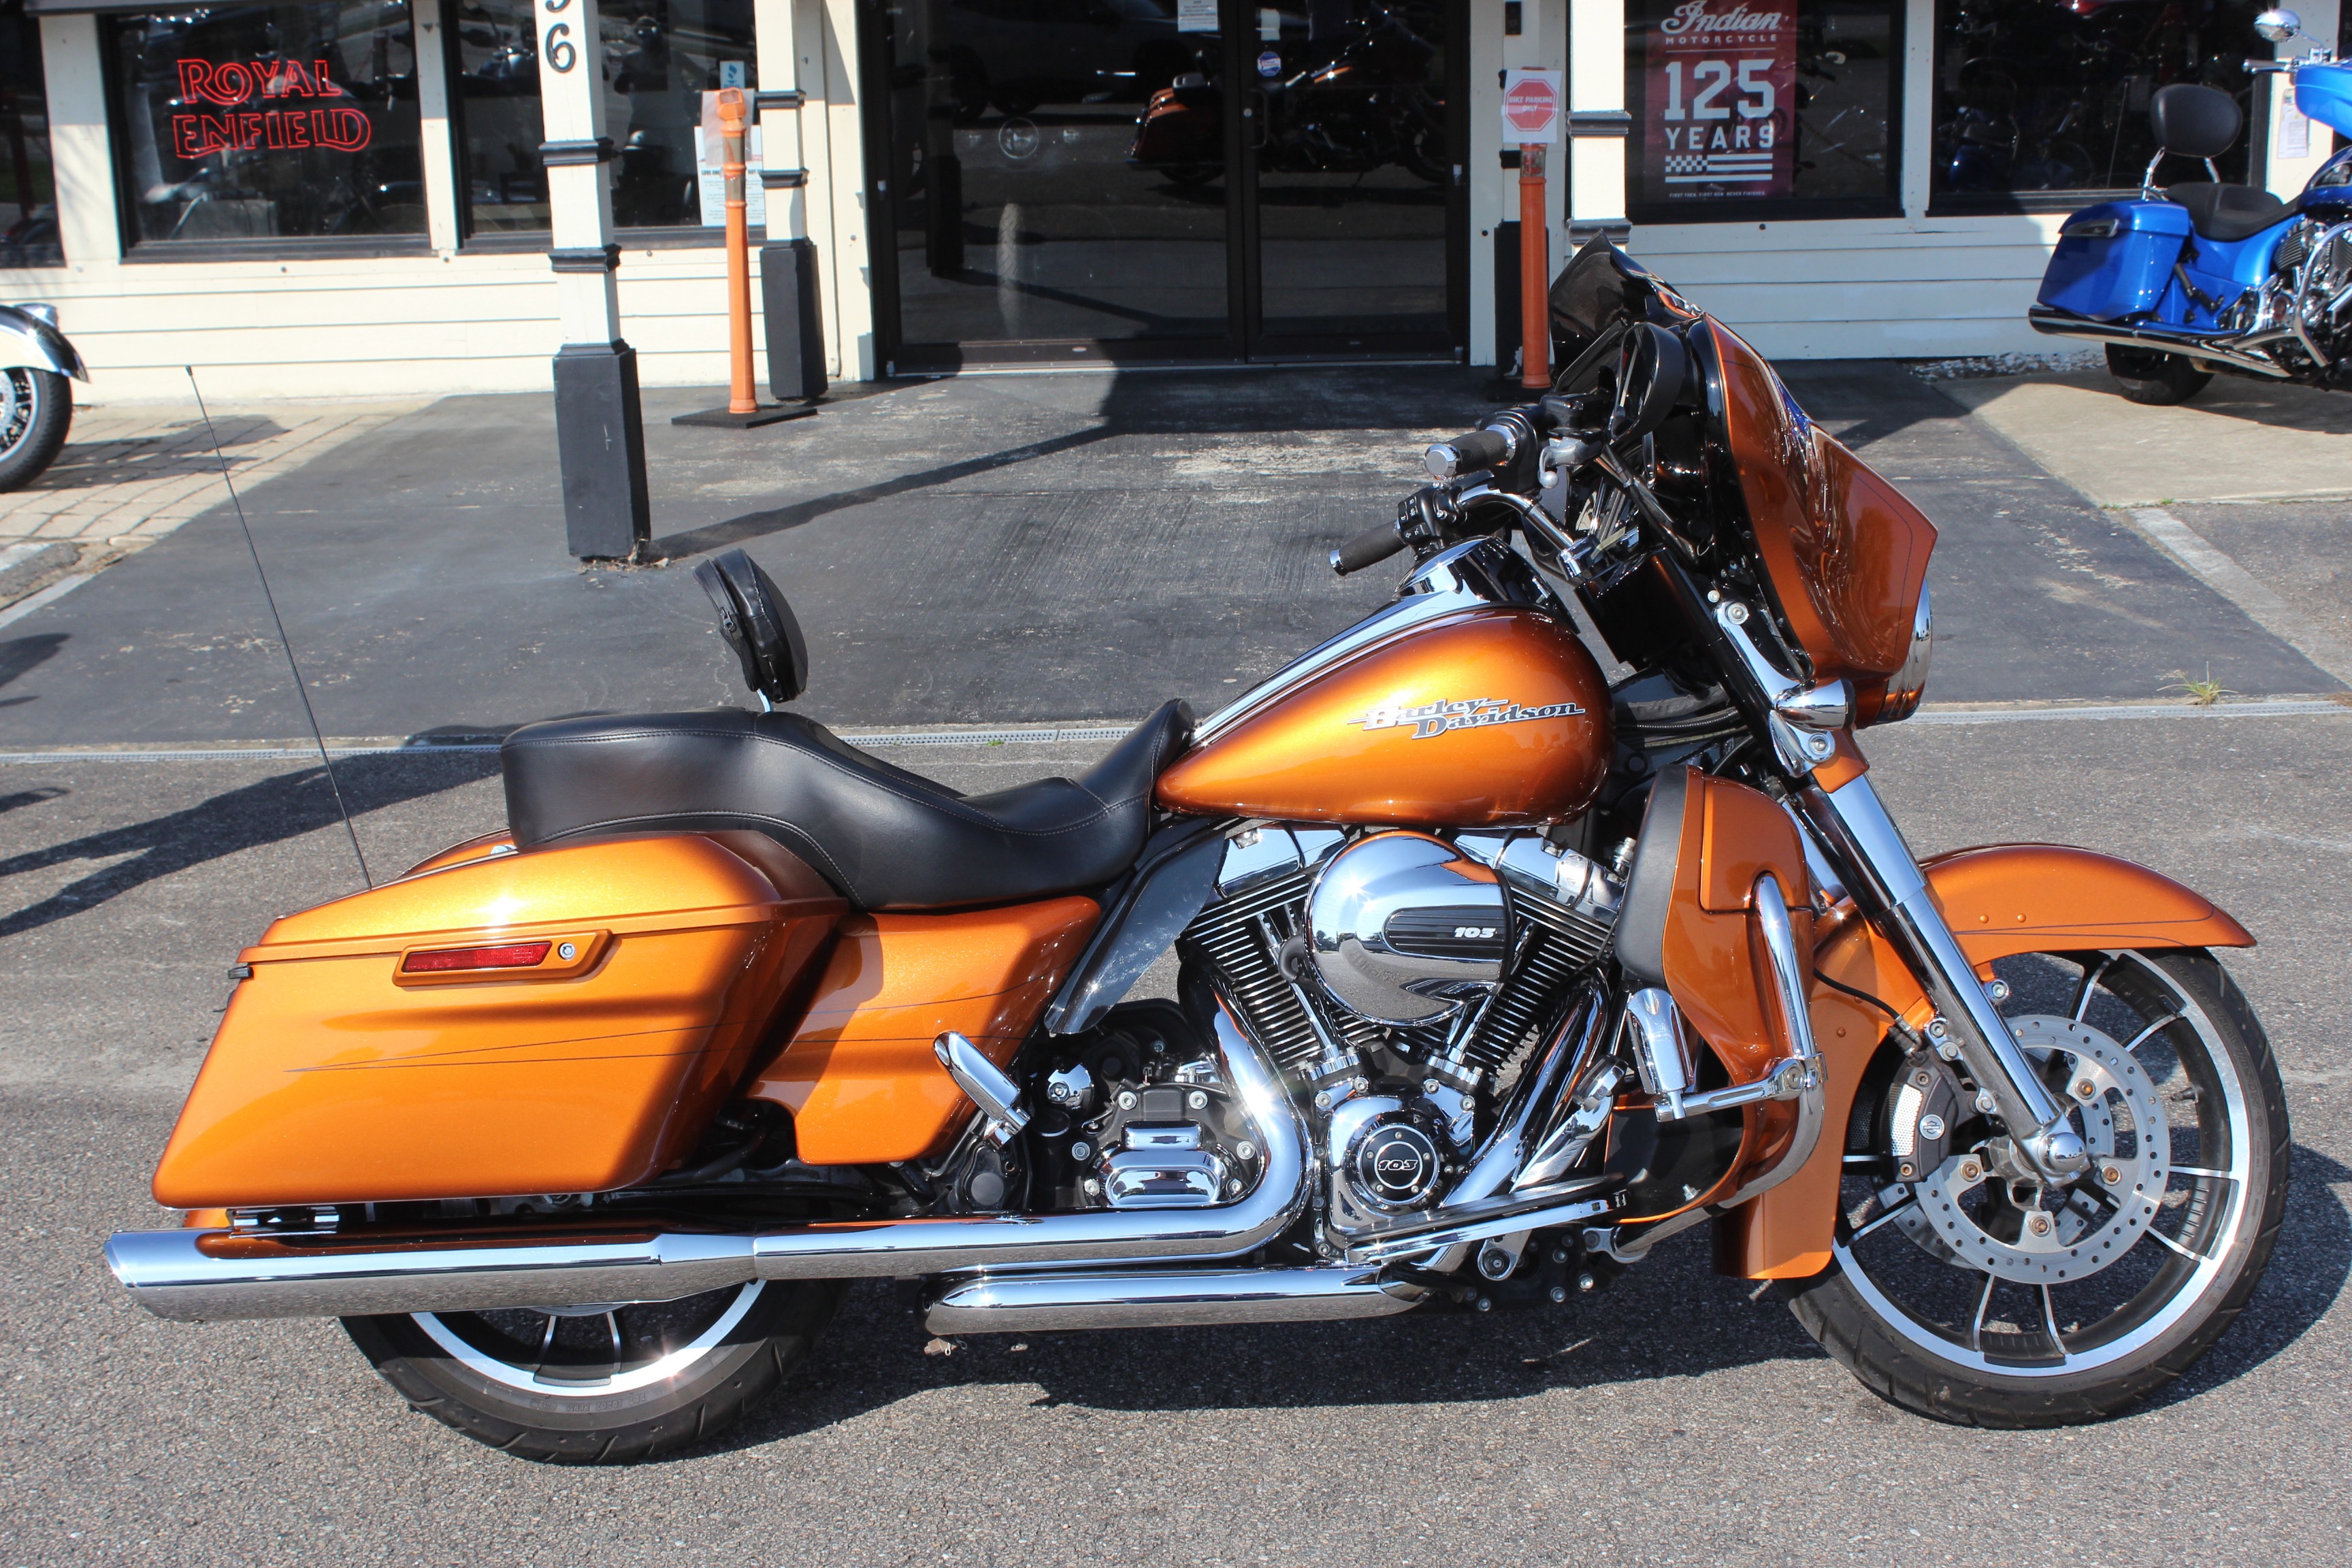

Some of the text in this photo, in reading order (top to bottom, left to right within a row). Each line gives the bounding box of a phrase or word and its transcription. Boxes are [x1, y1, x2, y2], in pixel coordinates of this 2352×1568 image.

[1661, 0, 1782, 34] Indian
[1665, 34, 1777, 44] MOTORCYCLE
[176, 59, 342, 105] ROYAL
[1665, 59, 1775, 120] 125
[173, 108, 372, 159] ENFIELD
[1665, 125, 1774, 150] YEARS
[1411, 703, 1586, 740] Davidson
[1454, 927, 1497, 938] 103
[1378, 1159, 1419, 1171] 103
